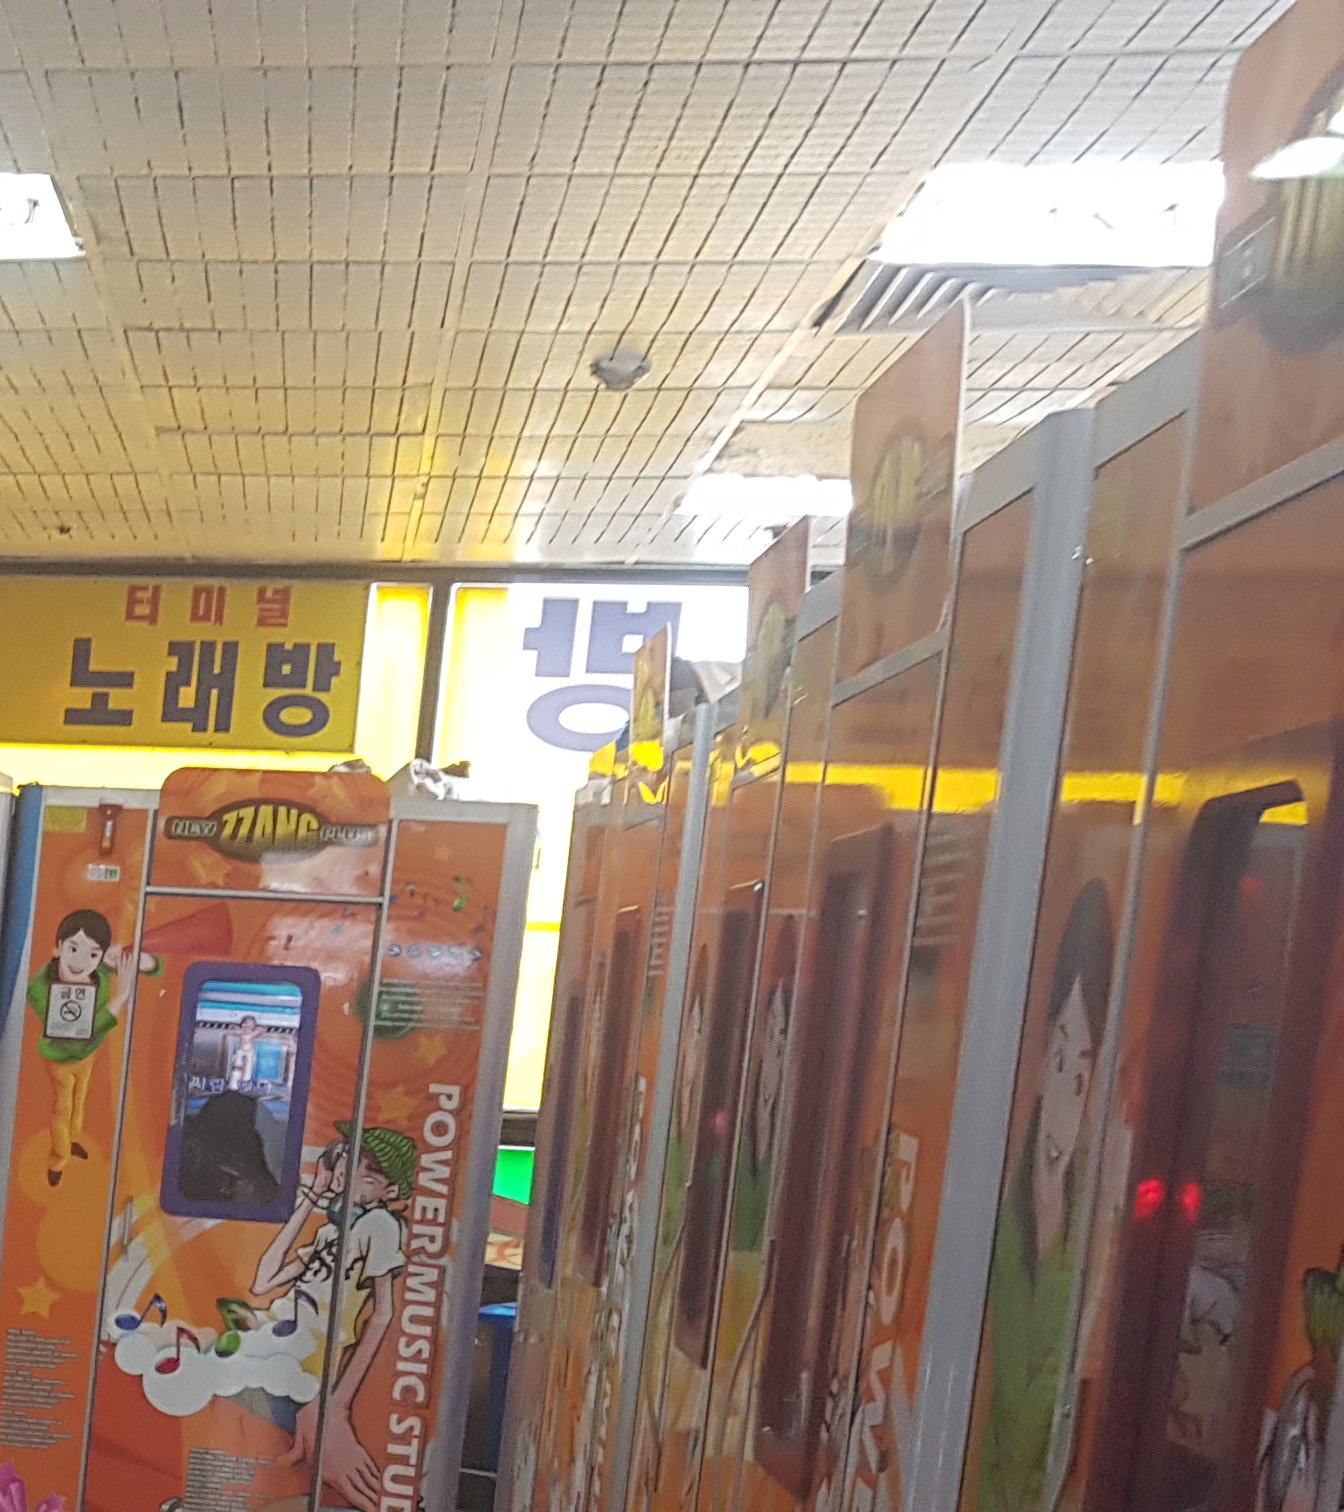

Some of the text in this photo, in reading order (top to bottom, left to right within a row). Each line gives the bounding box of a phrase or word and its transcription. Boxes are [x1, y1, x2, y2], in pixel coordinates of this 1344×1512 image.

[125, 583, 293, 628] 터미널
[63, 636, 342, 738] 노래방
[220, 804, 320, 852] ZZANG
[410, 1082, 461, 1256] POWER
[391, 1262, 442, 1405] MUSIC
